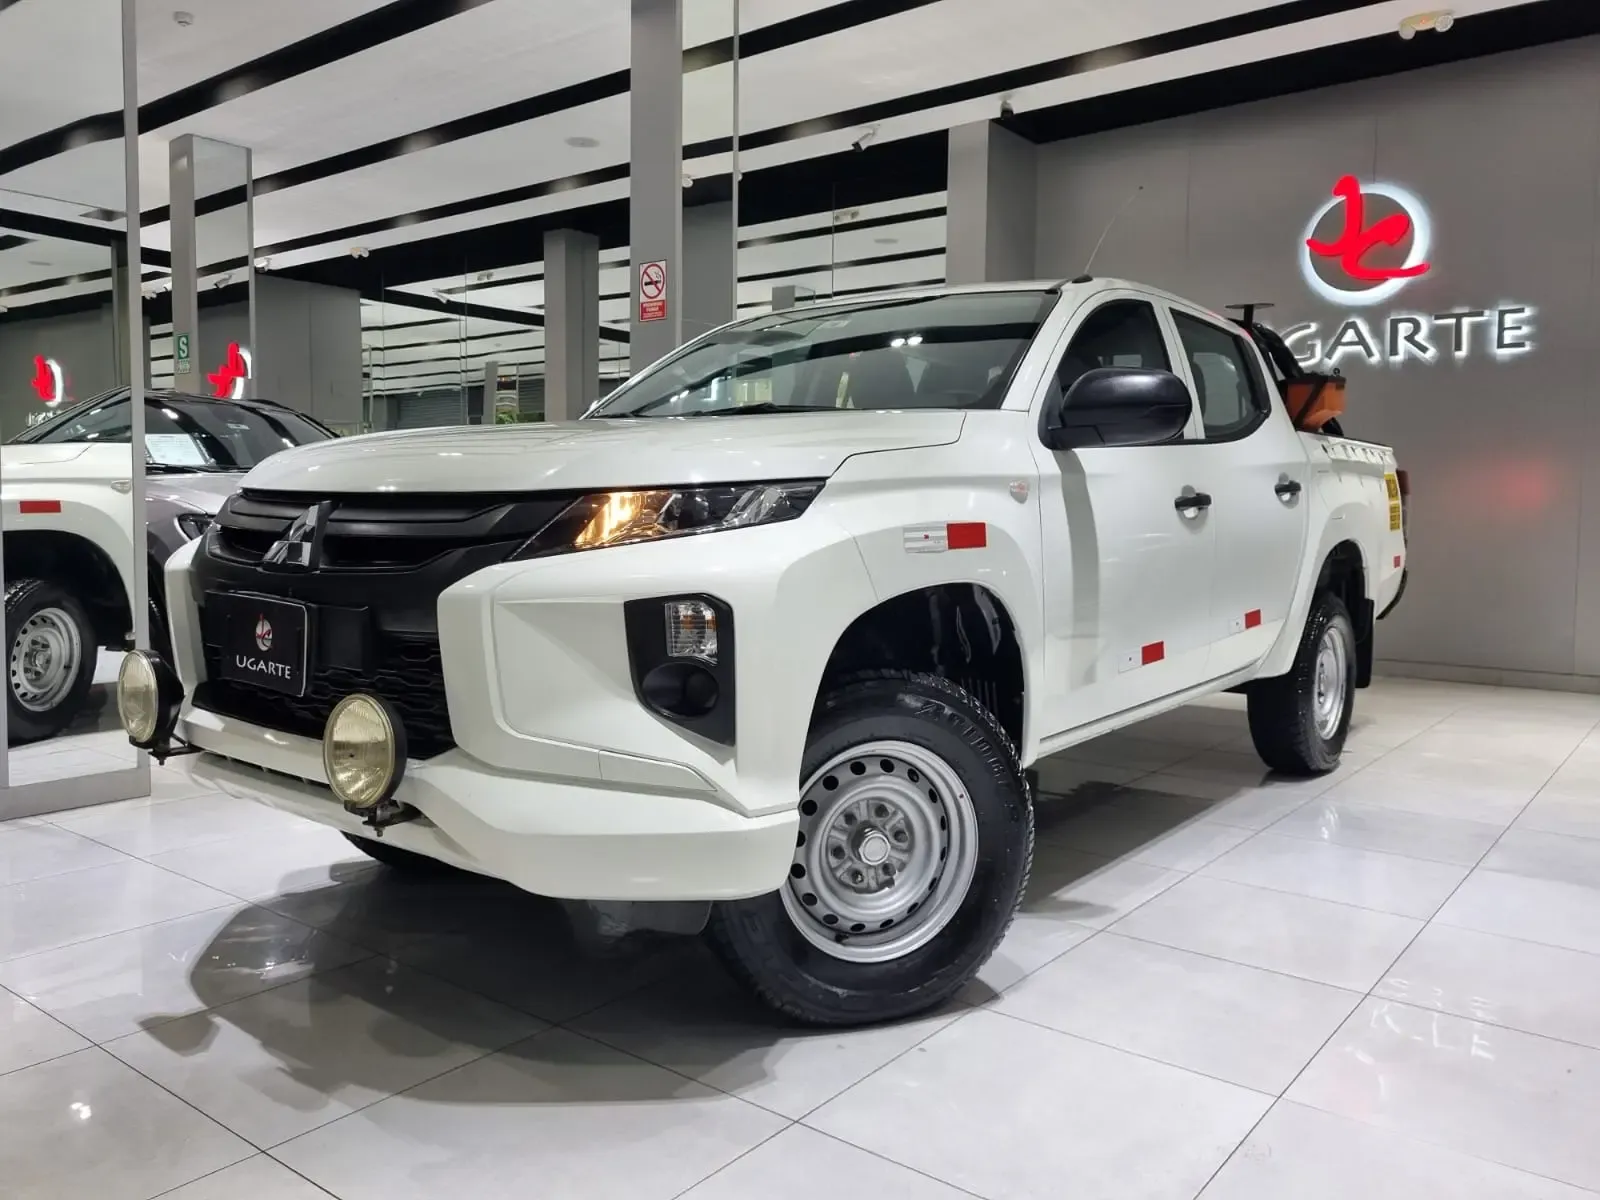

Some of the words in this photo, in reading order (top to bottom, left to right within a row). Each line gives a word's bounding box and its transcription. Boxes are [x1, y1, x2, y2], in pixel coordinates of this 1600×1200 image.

[179, 336, 188, 359] S
[1279, 305, 1531, 368] GARTE
[236, 654, 292, 680] UGARTE
